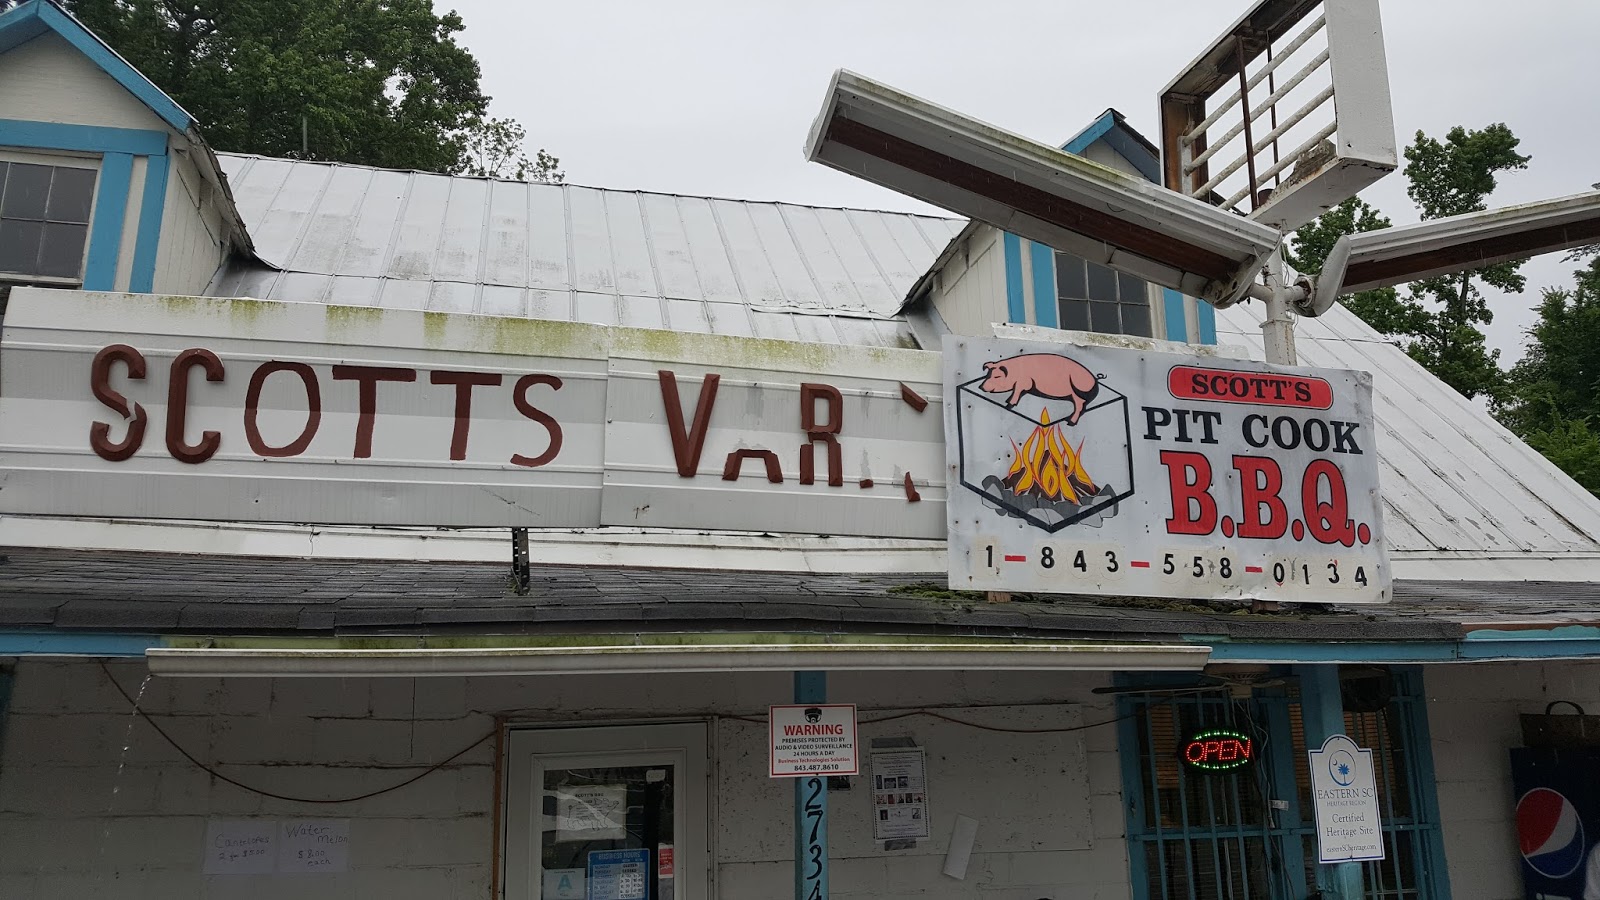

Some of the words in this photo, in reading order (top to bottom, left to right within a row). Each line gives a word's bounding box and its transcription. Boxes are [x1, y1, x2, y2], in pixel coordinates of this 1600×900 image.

[1191, 373, 1312, 402] SCOTT'S
[90, 344, 563, 467] SCOTTS
[1142, 406, 1222, 444] PIT
[1242, 413, 1363, 455] COOK
[1159, 449, 1371, 548] B.B.Q.
[783, 724, 843, 736] WARNING
[1186, 739, 1251, 762] OPEN
[1317, 788, 1359, 799] EASTERN
[1361, 787, 1374, 798] SC
[1332, 812, 1365, 823] Certified
[285, 823, 330, 838] Water
[1326, 827, 1357, 837] Heritage
[1359, 826, 1374, 835] Site
[557, 874, 572, 890] A
